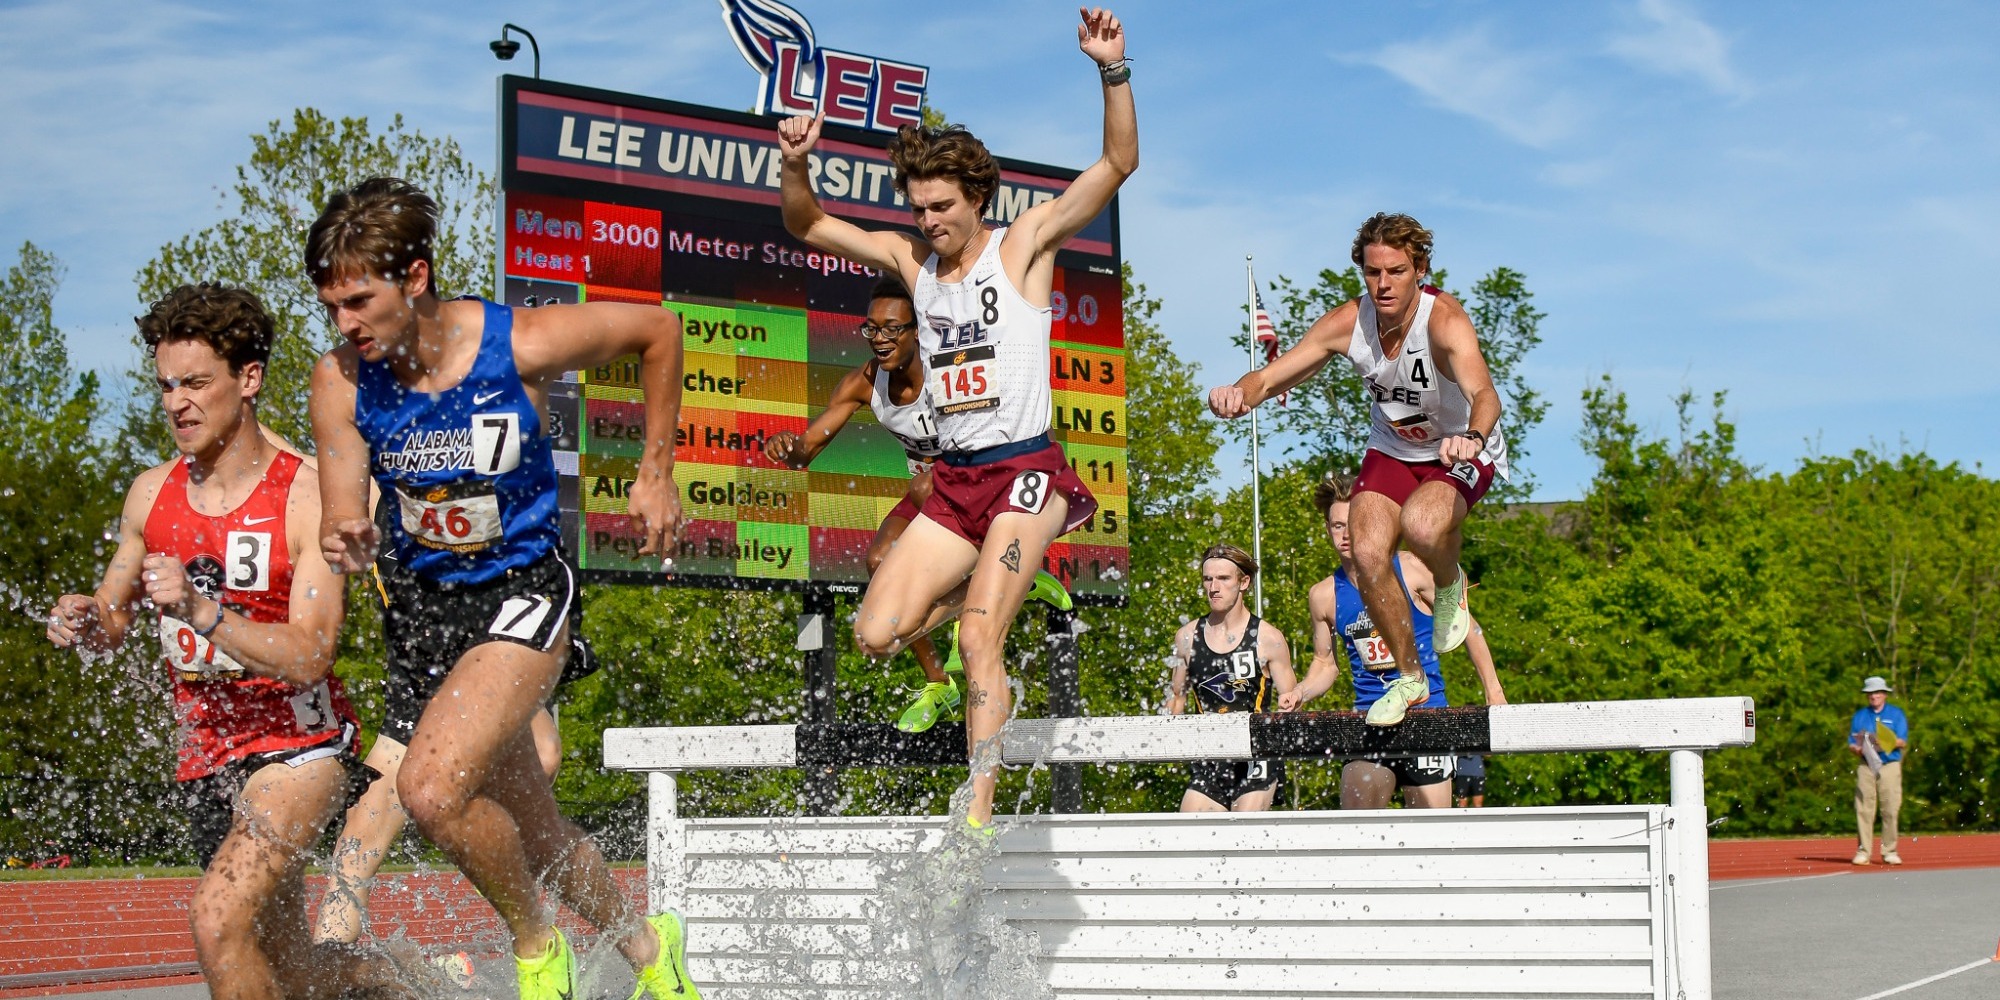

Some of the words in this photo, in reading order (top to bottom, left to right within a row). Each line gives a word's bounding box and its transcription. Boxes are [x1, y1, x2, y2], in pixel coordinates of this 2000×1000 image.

[771, 40, 928, 132] LEE
[558, 116, 645, 168] LEE
[515, 208, 582, 241] Men
[592, 219, 659, 249] 3000
[669, 230, 753, 261] Meter
[515, 246, 573, 272] Heat
[581, 255, 591, 273] 1
[981, 286, 999, 325] 8
[939, 319, 988, 350] LEE
[941, 366, 987, 400] 145
[1055, 355, 1091, 382] LN
[1100, 361, 1114, 385] 3
[1411, 358, 1429, 388] 4
[943, 400, 991, 414] CHAMPIONSHIPS
[1376, 387, 1421, 407] LEE
[918, 413, 932, 436] 1
[1056, 406, 1092, 432] LN
[1101, 410, 1115, 434] 6
[404, 427, 473, 453] ALABAMA
[482, 418, 509, 472] 7
[1087, 459, 1113, 483] 11
[1458, 465, 1475, 481] 4
[689, 481, 787, 507] Golden
[1017, 472, 1041, 509] 8
[421, 507, 472, 538] 46
[1102, 510, 1117, 534] 5
[234, 535, 260, 588] 3
[708, 538, 792, 569] Bailey
[502, 595, 543, 632] 7
[1239, 653, 1251, 677] 5
[1367, 640, 1390, 662] 39
